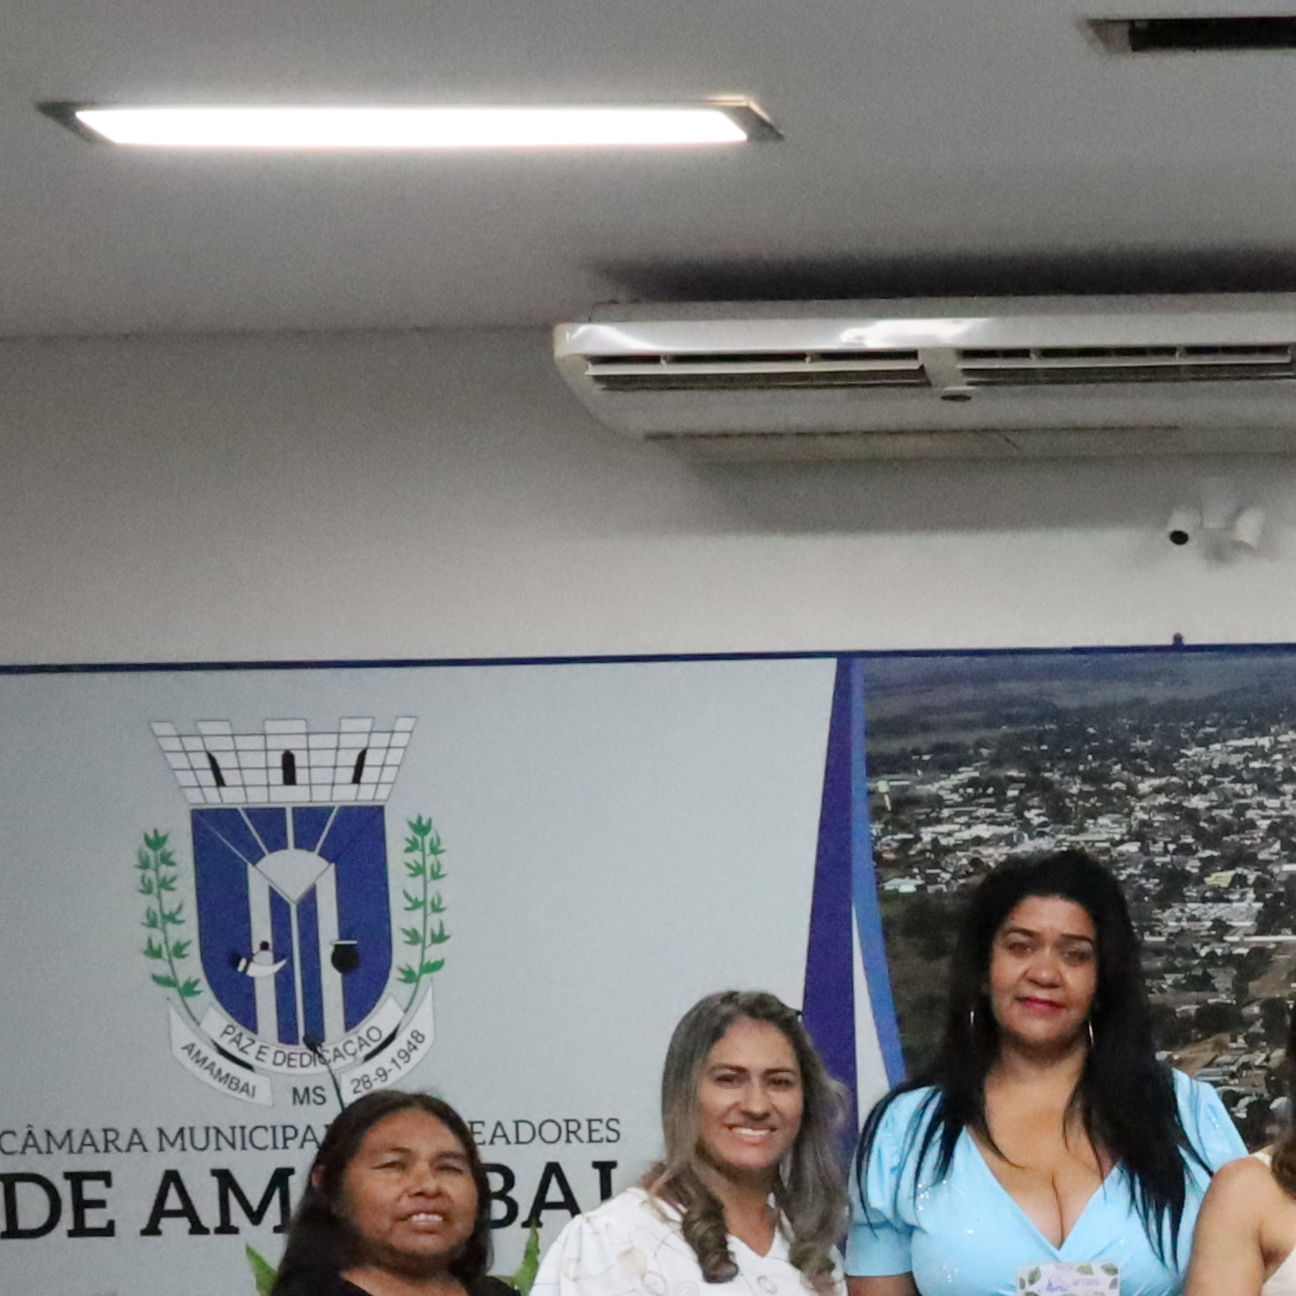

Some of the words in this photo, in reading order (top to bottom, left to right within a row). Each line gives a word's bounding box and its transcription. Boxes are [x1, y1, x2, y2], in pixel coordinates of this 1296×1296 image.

[220, 1024, 256, 1055] PAZ
[255, 1044, 270, 1062] E
[351, 1030, 425, 1094] 28-9-1948
[181, 1042, 256, 1098] AMAMBAI
[292, 1086, 327, 1106] MS
[0, 1125, 149, 1155] CÂMARA
[156, 1124, 332, 1153] MUNICIPA
[467, 1117, 621, 1146] EADORES
[0, 1170, 116, 1239] DE
